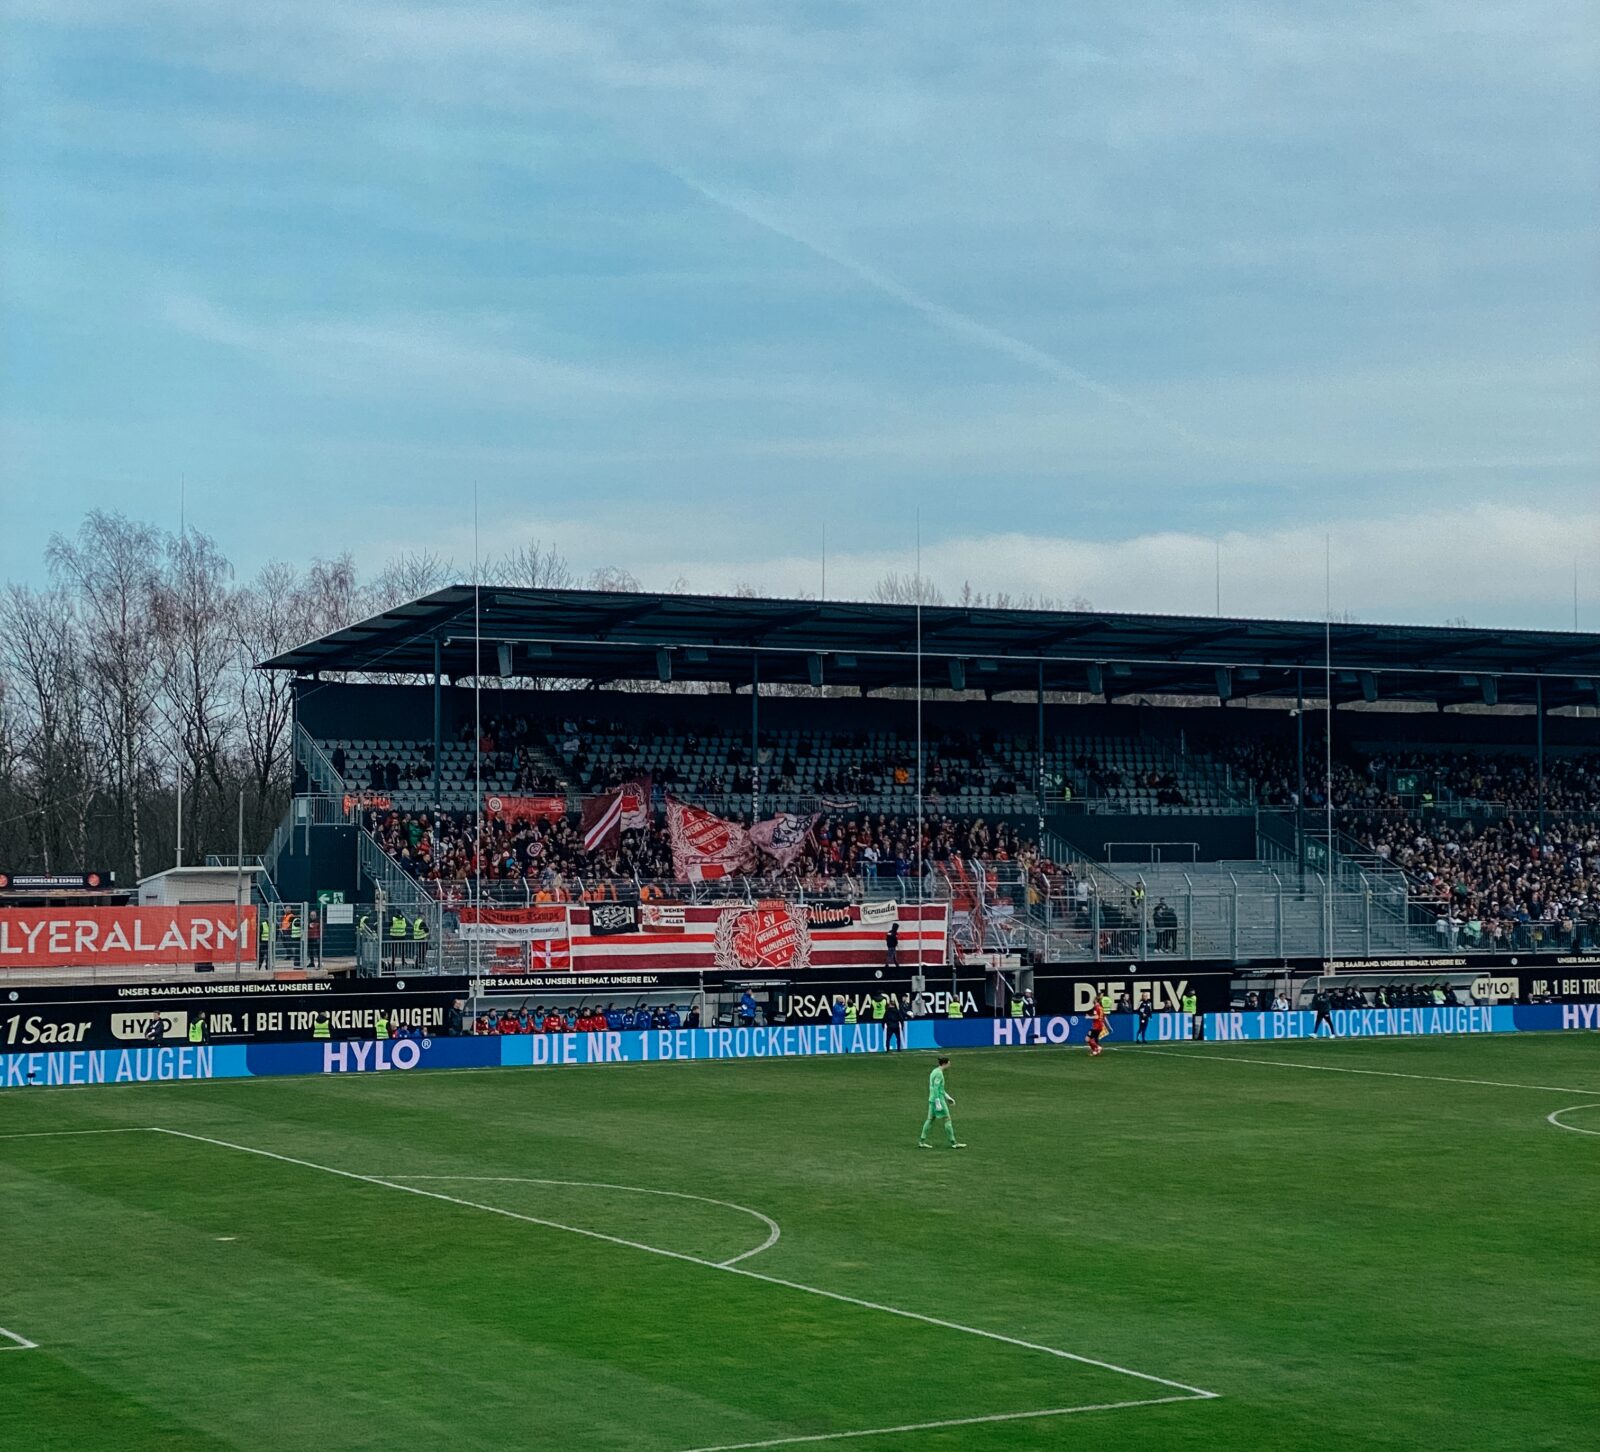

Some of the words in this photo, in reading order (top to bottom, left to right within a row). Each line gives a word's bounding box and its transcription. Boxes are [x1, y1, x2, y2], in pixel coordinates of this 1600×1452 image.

[764, 914, 776, 926] SV
[757, 928, 779, 944] WEHEN
[118, 988, 149, 996] UNSER
[151, 987, 203, 995] SAARLAND.
[204, 985, 240, 994] UNSERE
[242, 984, 277, 993] HEIMAT.
[1553, 980, 1558, 994] 1
[1563, 979, 1579, 994] BEI
[210, 1014, 237, 1033] NR.
[242, 1013, 249, 1032] 1
[256, 1013, 282, 1032] BEI
[1159, 1013, 1194, 1040] DIE
[1215, 1013, 1248, 1040] NR.
[1257, 1012, 1266, 1039] 1
[1274, 1011, 1303, 1038] BEI
[1430, 1006, 1492, 1033] AUGEN
[1563, 1004, 1600, 1029] HY
[533, 1033, 577, 1064] DIE
[588, 1031, 628, 1062] NR.
[639, 1030, 648, 1060] 1
[659, 1029, 695, 1059] BEI
[705, 1025, 843, 1058] TROCKENEN
[852, 1022, 908, 1053] AUN
[116, 1046, 213, 1085] AUGEN
